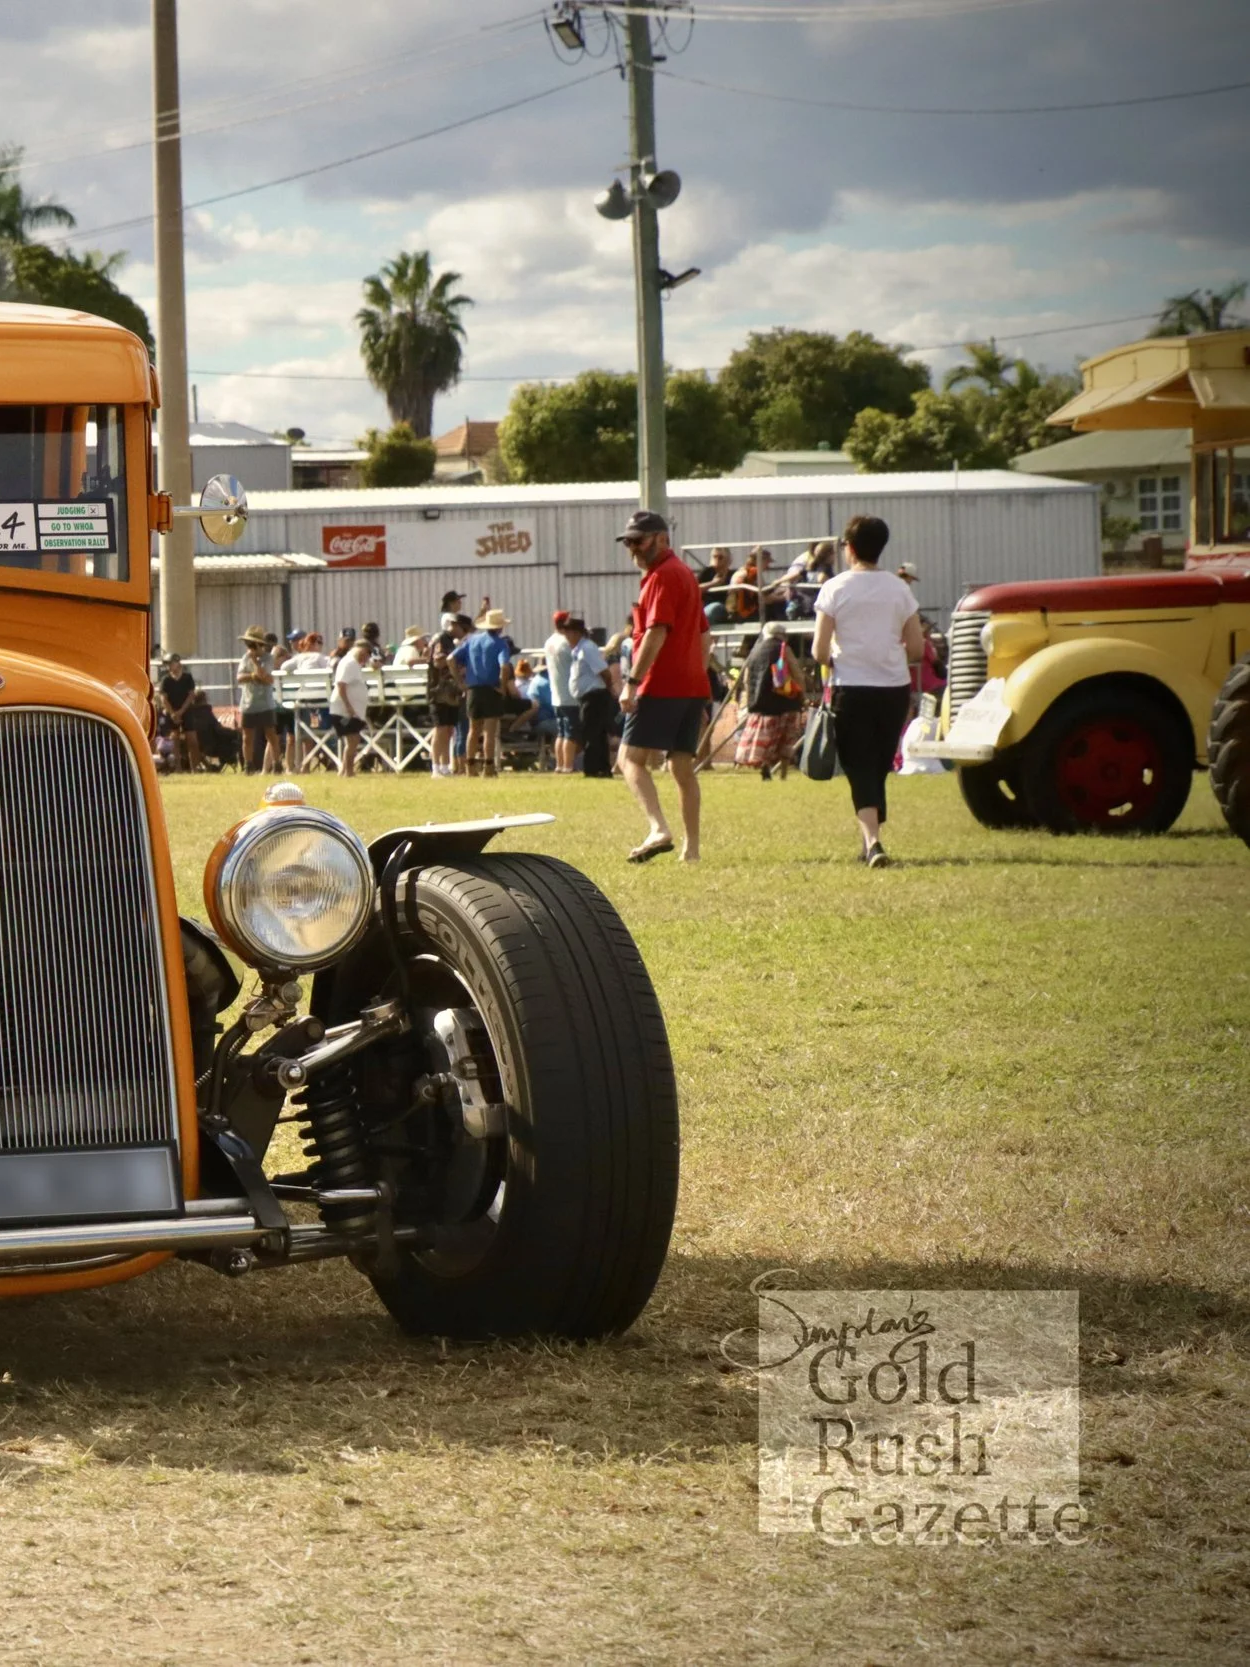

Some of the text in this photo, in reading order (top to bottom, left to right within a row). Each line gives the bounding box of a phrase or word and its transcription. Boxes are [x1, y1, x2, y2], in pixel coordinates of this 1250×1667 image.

[57, 506, 86, 515] JUDGING
[51, 522, 94, 531] GO TO WHOA
[488, 521, 514, 534] THE
[44, 537, 106, 547] OBSERVATION RALLY
[475, 531, 531, 557] SHED
